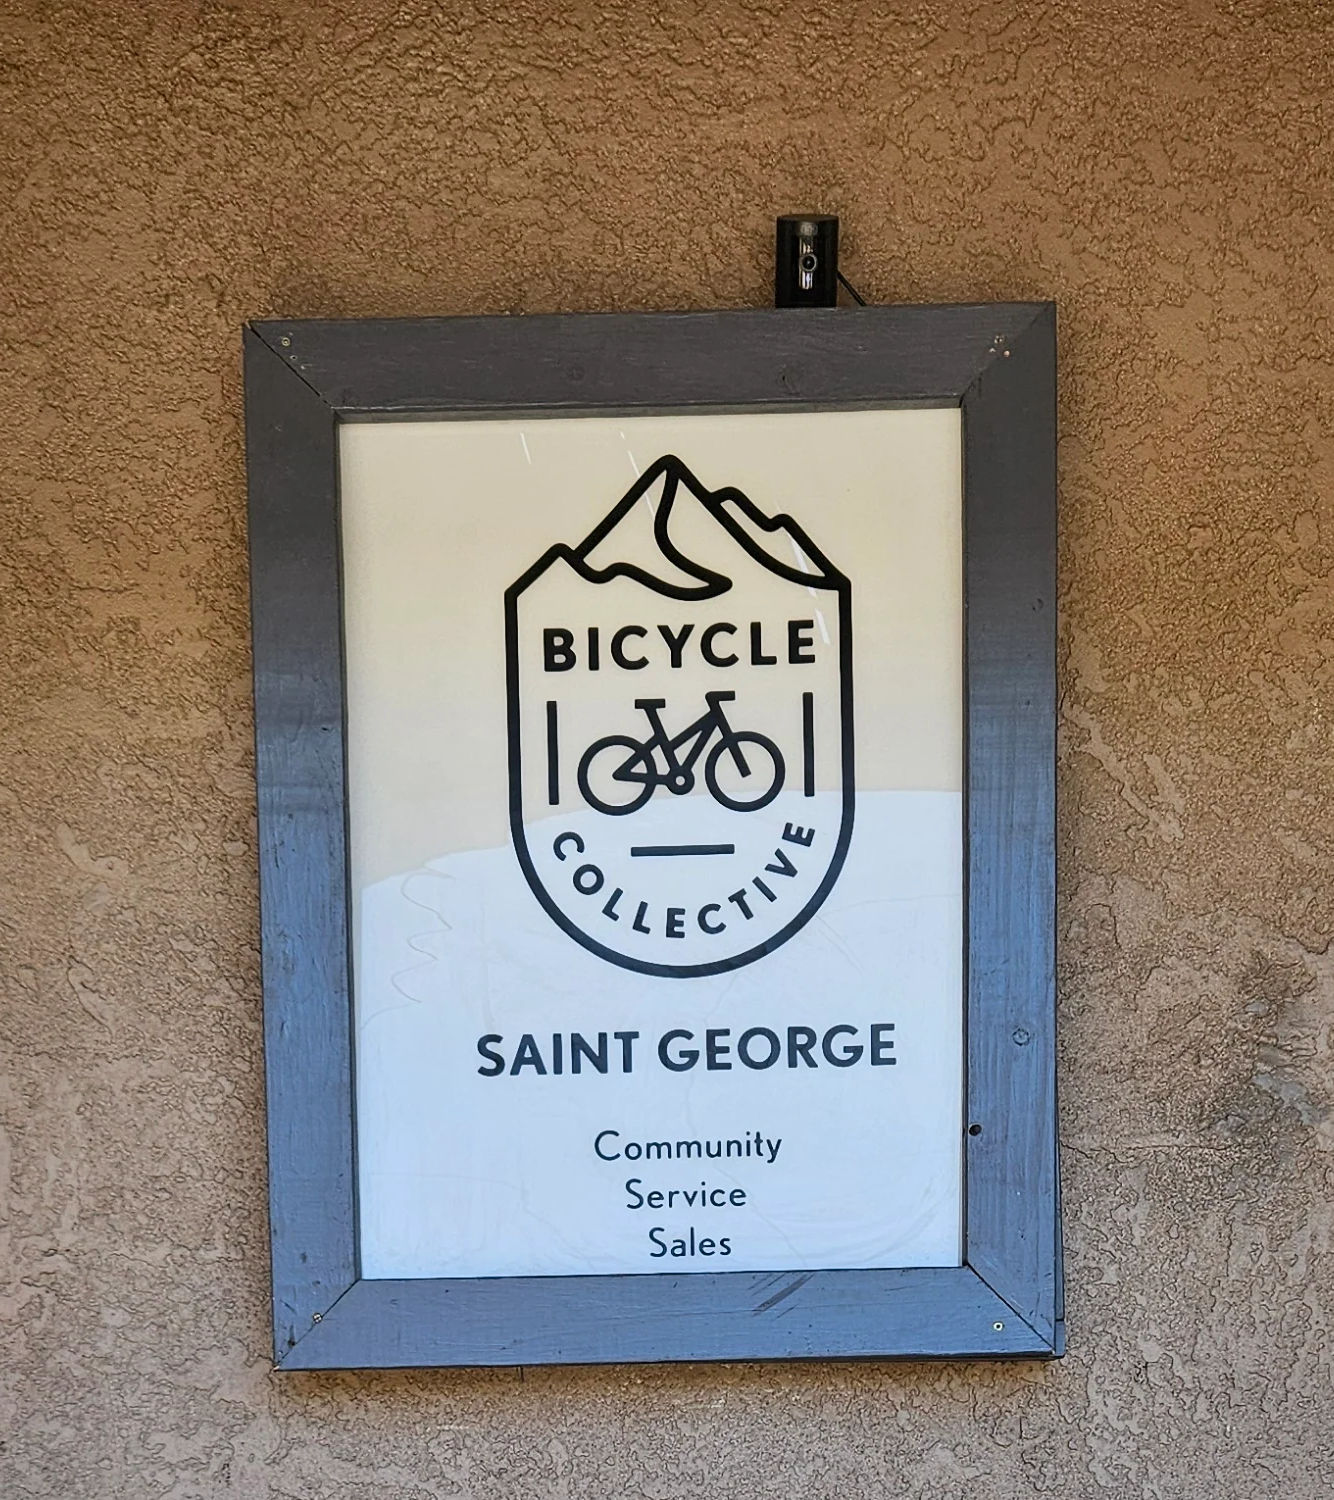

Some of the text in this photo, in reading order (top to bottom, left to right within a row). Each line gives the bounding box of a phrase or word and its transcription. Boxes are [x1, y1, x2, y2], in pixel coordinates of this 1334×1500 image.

[543, 619, 816, 672] BICYCLE
[553, 821, 816, 938] COLLECTIVE
[476, 1023, 897, 1077] SAINT GEORGE
[594, 1130, 783, 1165] Community
[625, 1180, 747, 1211] Service
[648, 1228, 733, 1258] Sales
